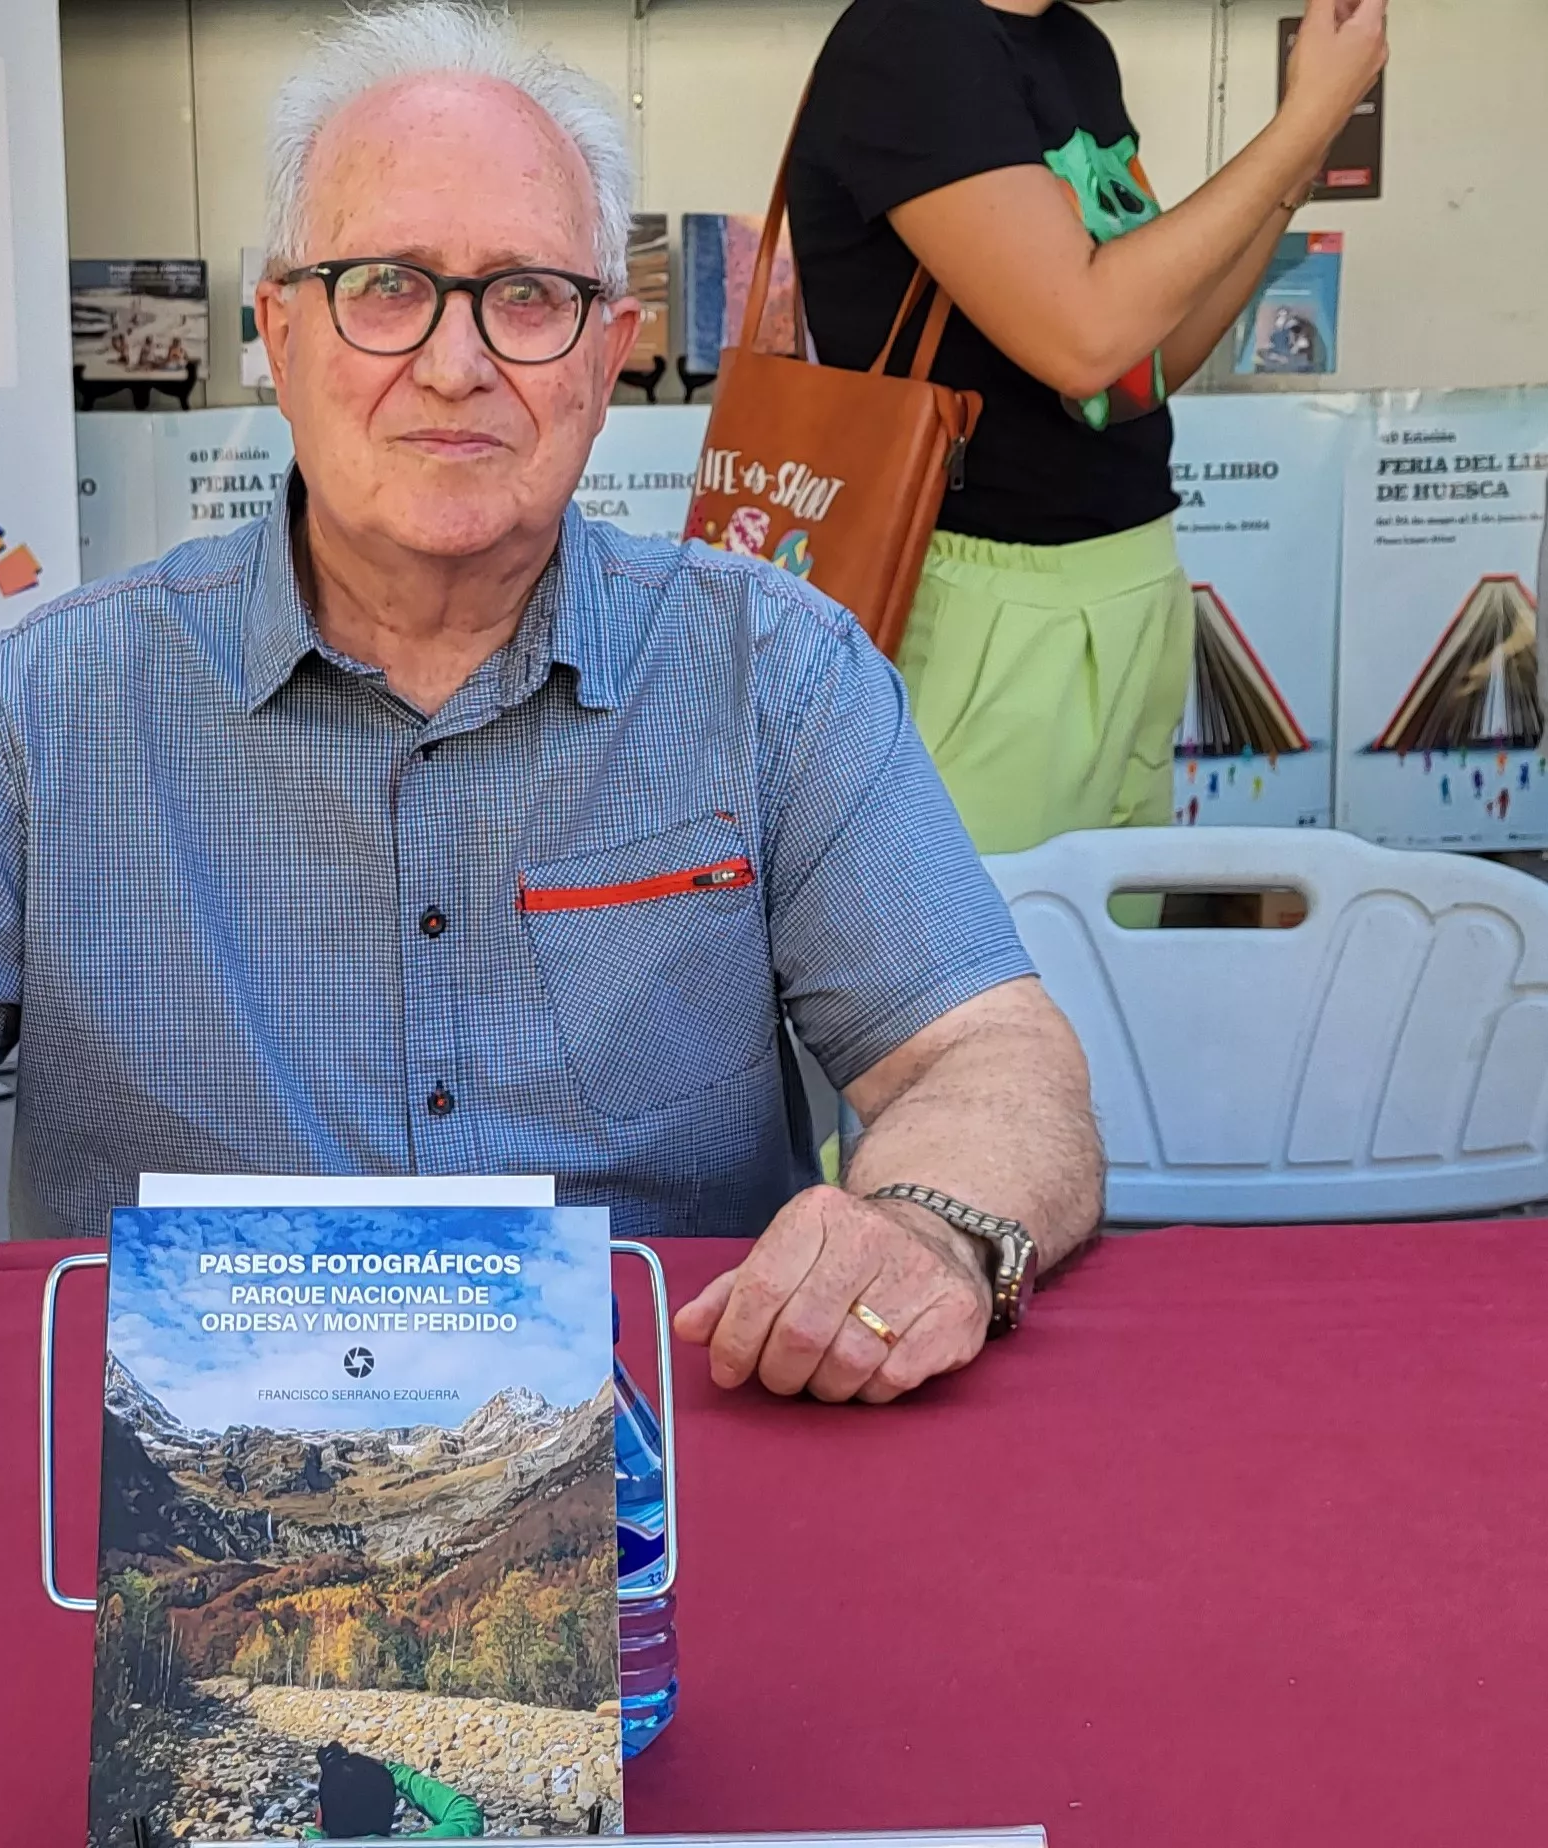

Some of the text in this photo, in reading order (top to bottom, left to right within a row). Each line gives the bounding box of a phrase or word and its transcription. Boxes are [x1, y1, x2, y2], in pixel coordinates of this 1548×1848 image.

[1204, 460, 1279, 480] LIBRO
[1377, 453, 1548, 475] FERIA DEL LIB
[190, 475, 264, 494] FERIA
[695, 448, 742, 496] LIFE
[769, 461, 846, 521] SHORT
[1376, 480, 1510, 502] DE HUESCA
[191, 501, 225, 519] DE
[200, 1250, 521, 1275] PASEOS FOTOGRÁFICOS
[231, 1286, 489, 1306] PARQUE NACIONAL DE
[201, 1313, 517, 1332] ORDESA Y MONTE PERDIDO
[258, 1389, 460, 1401] FRANCISCO SERRANO EZQUERRA
